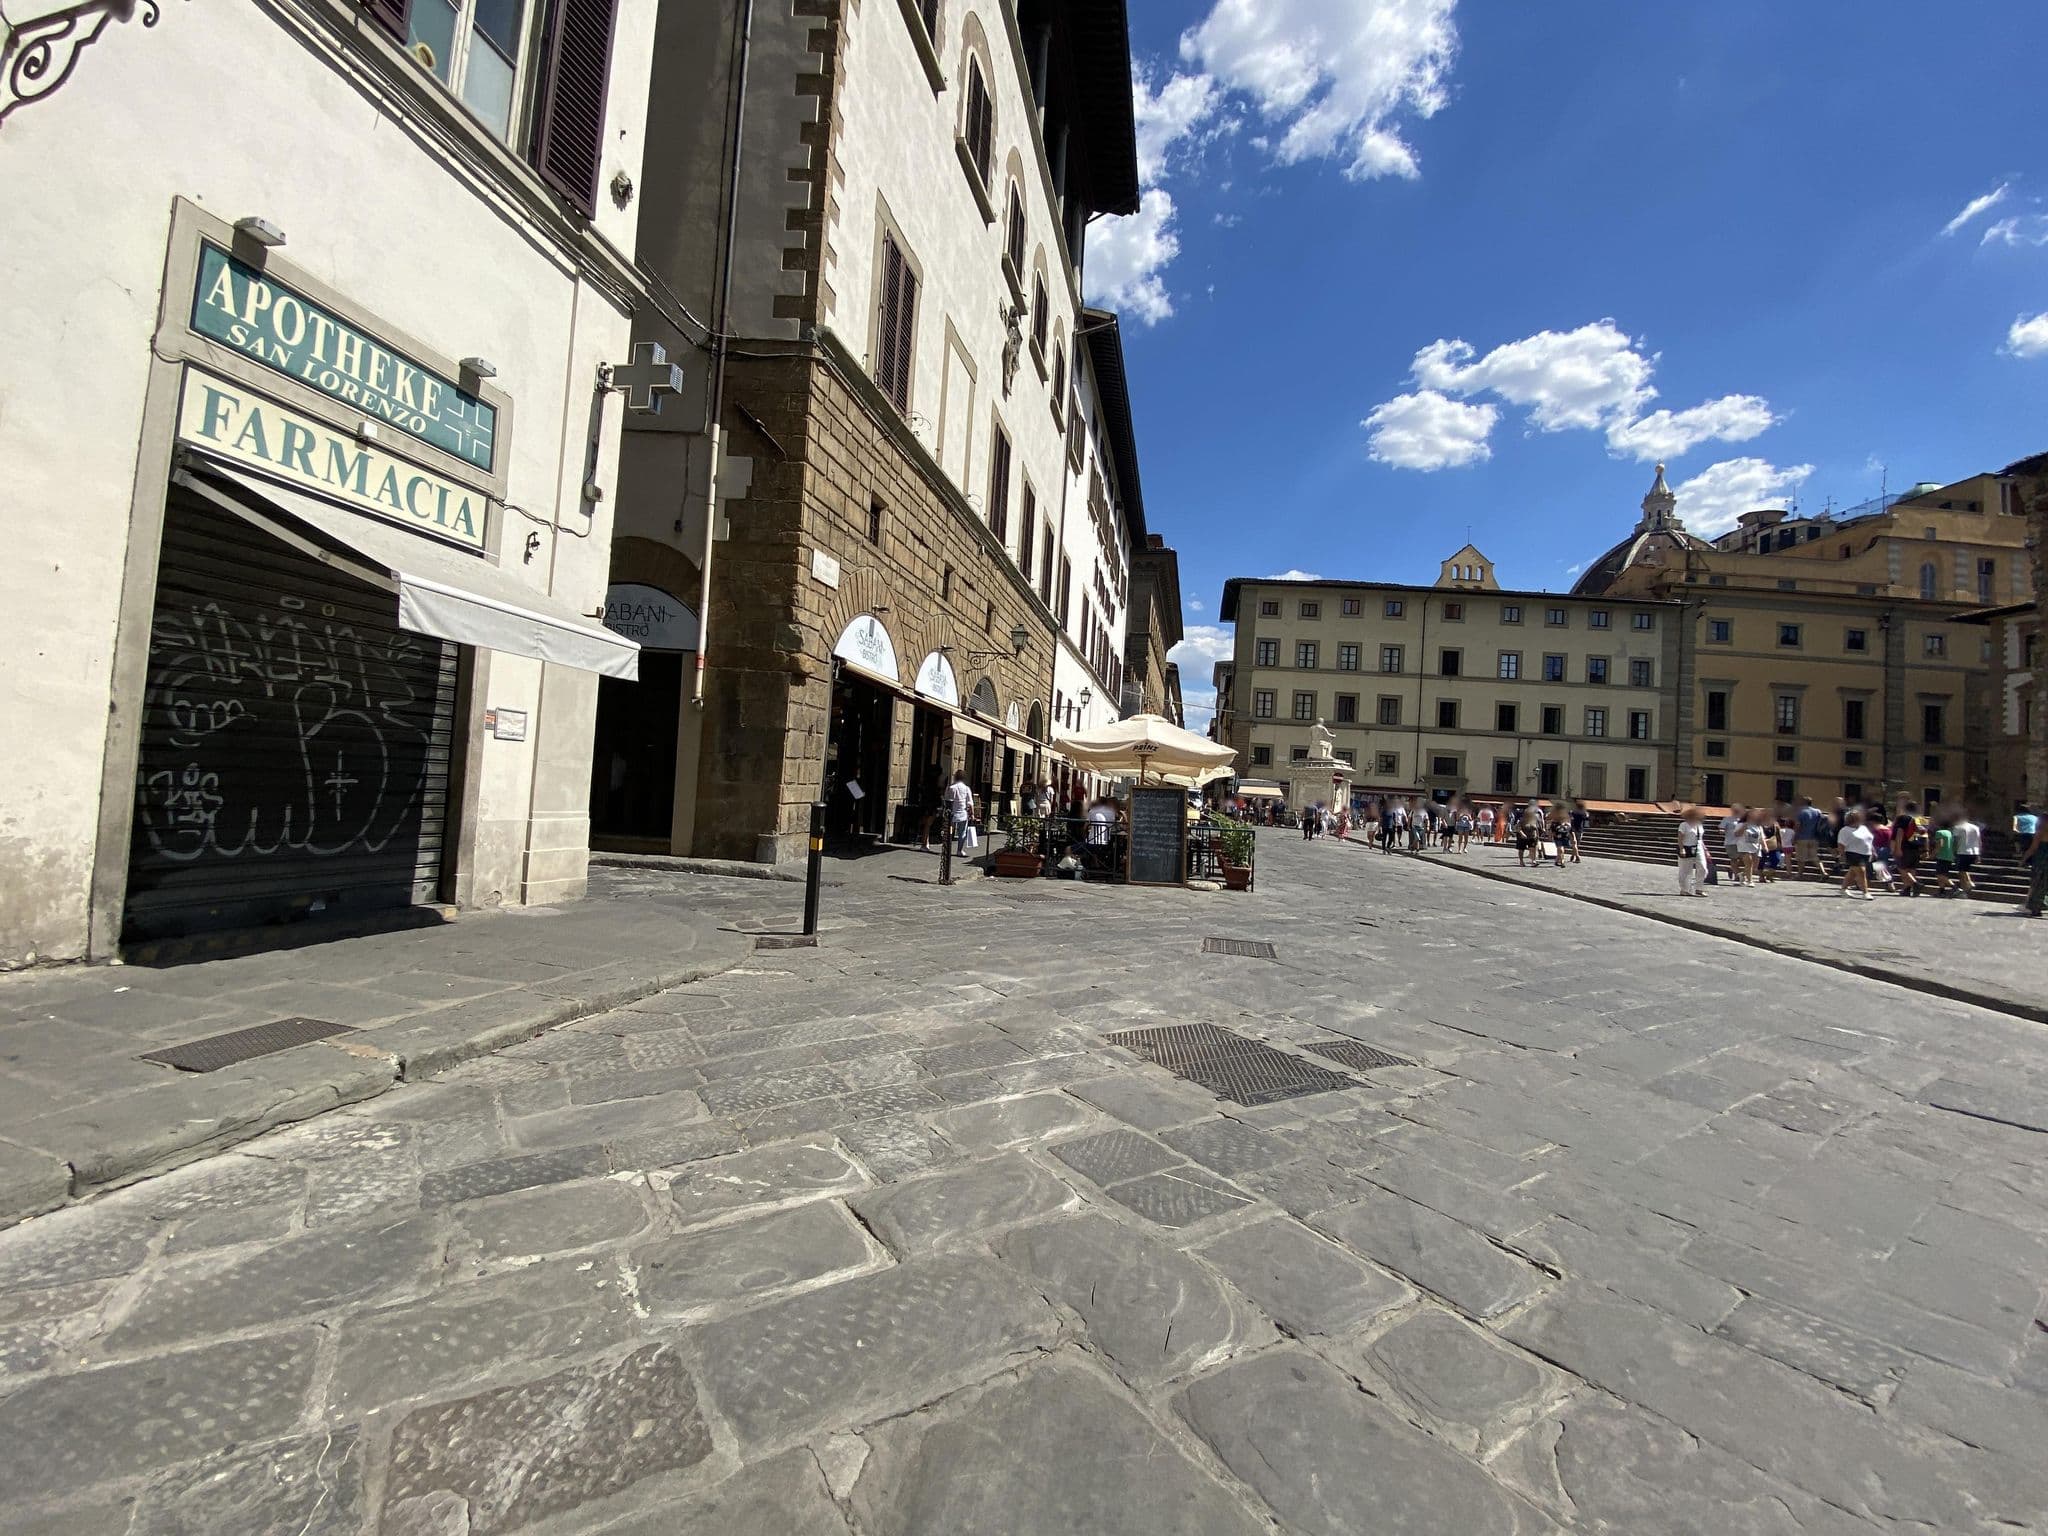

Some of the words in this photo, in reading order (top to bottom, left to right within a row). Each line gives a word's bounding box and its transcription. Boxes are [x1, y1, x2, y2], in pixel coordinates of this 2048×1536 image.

[205, 261, 443, 421] APOTHEKE
[225, 324, 295, 368] SAN
[302, 360, 428, 434] LORENZO
[196, 384, 478, 538] FARMACIA
[603, 603, 666, 623] ABANI
